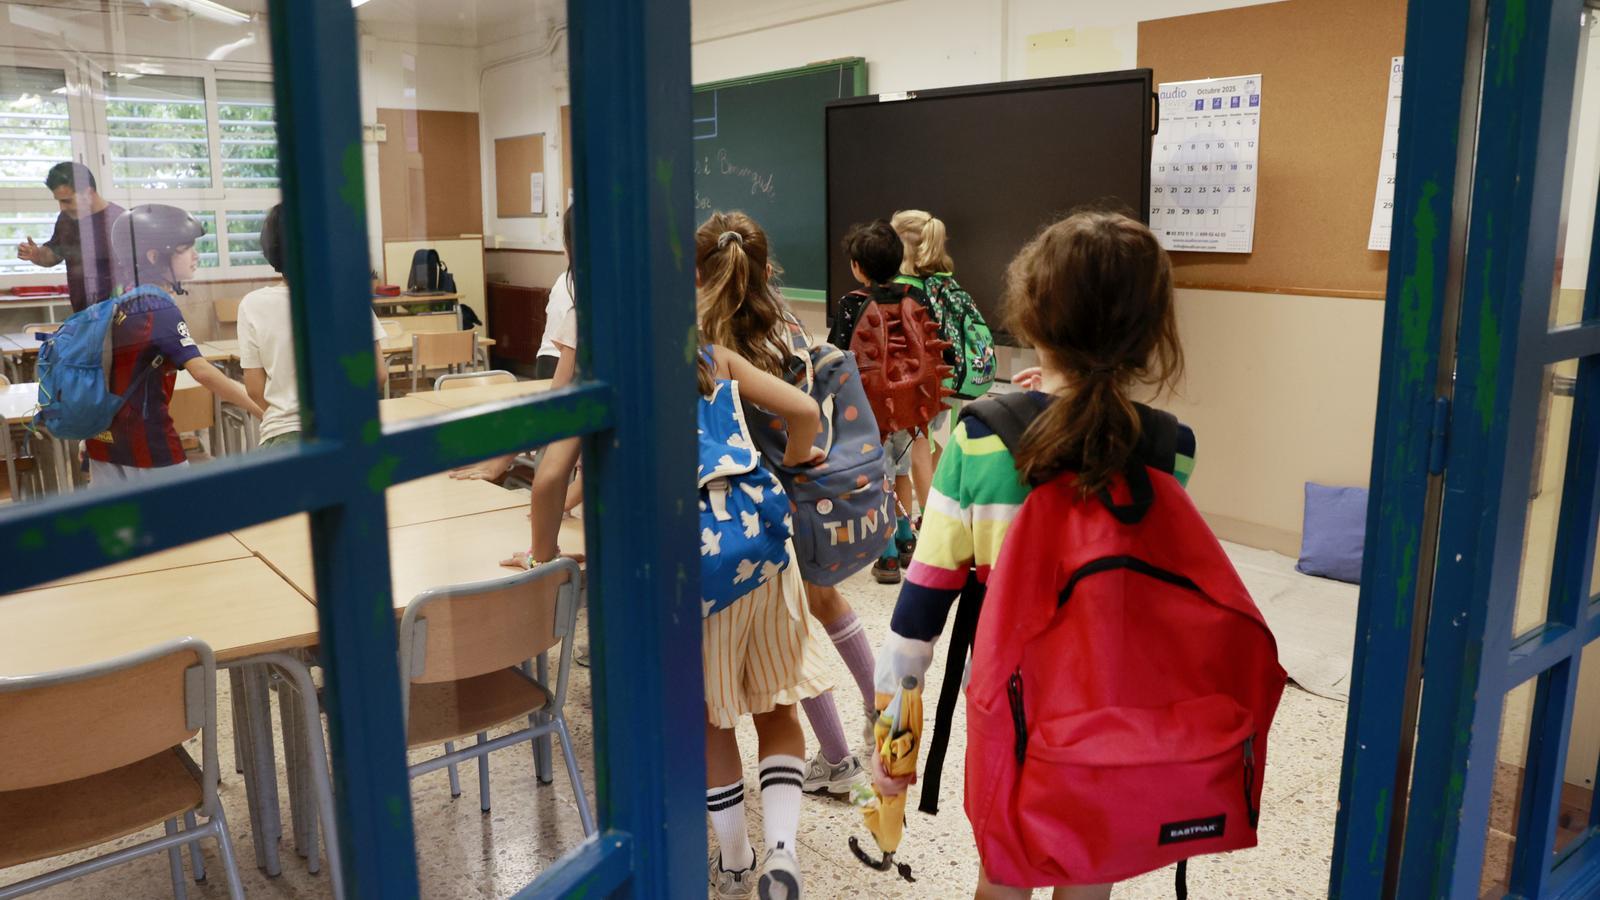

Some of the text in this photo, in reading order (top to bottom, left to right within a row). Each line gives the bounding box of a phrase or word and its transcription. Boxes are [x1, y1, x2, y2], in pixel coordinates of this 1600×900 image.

[1160, 86, 1187, 99] audio
[1197, 85, 1237, 95] Octubre 2025
[823, 495, 889, 546] TINY
[1170, 825, 1215, 837] EASTPAK
